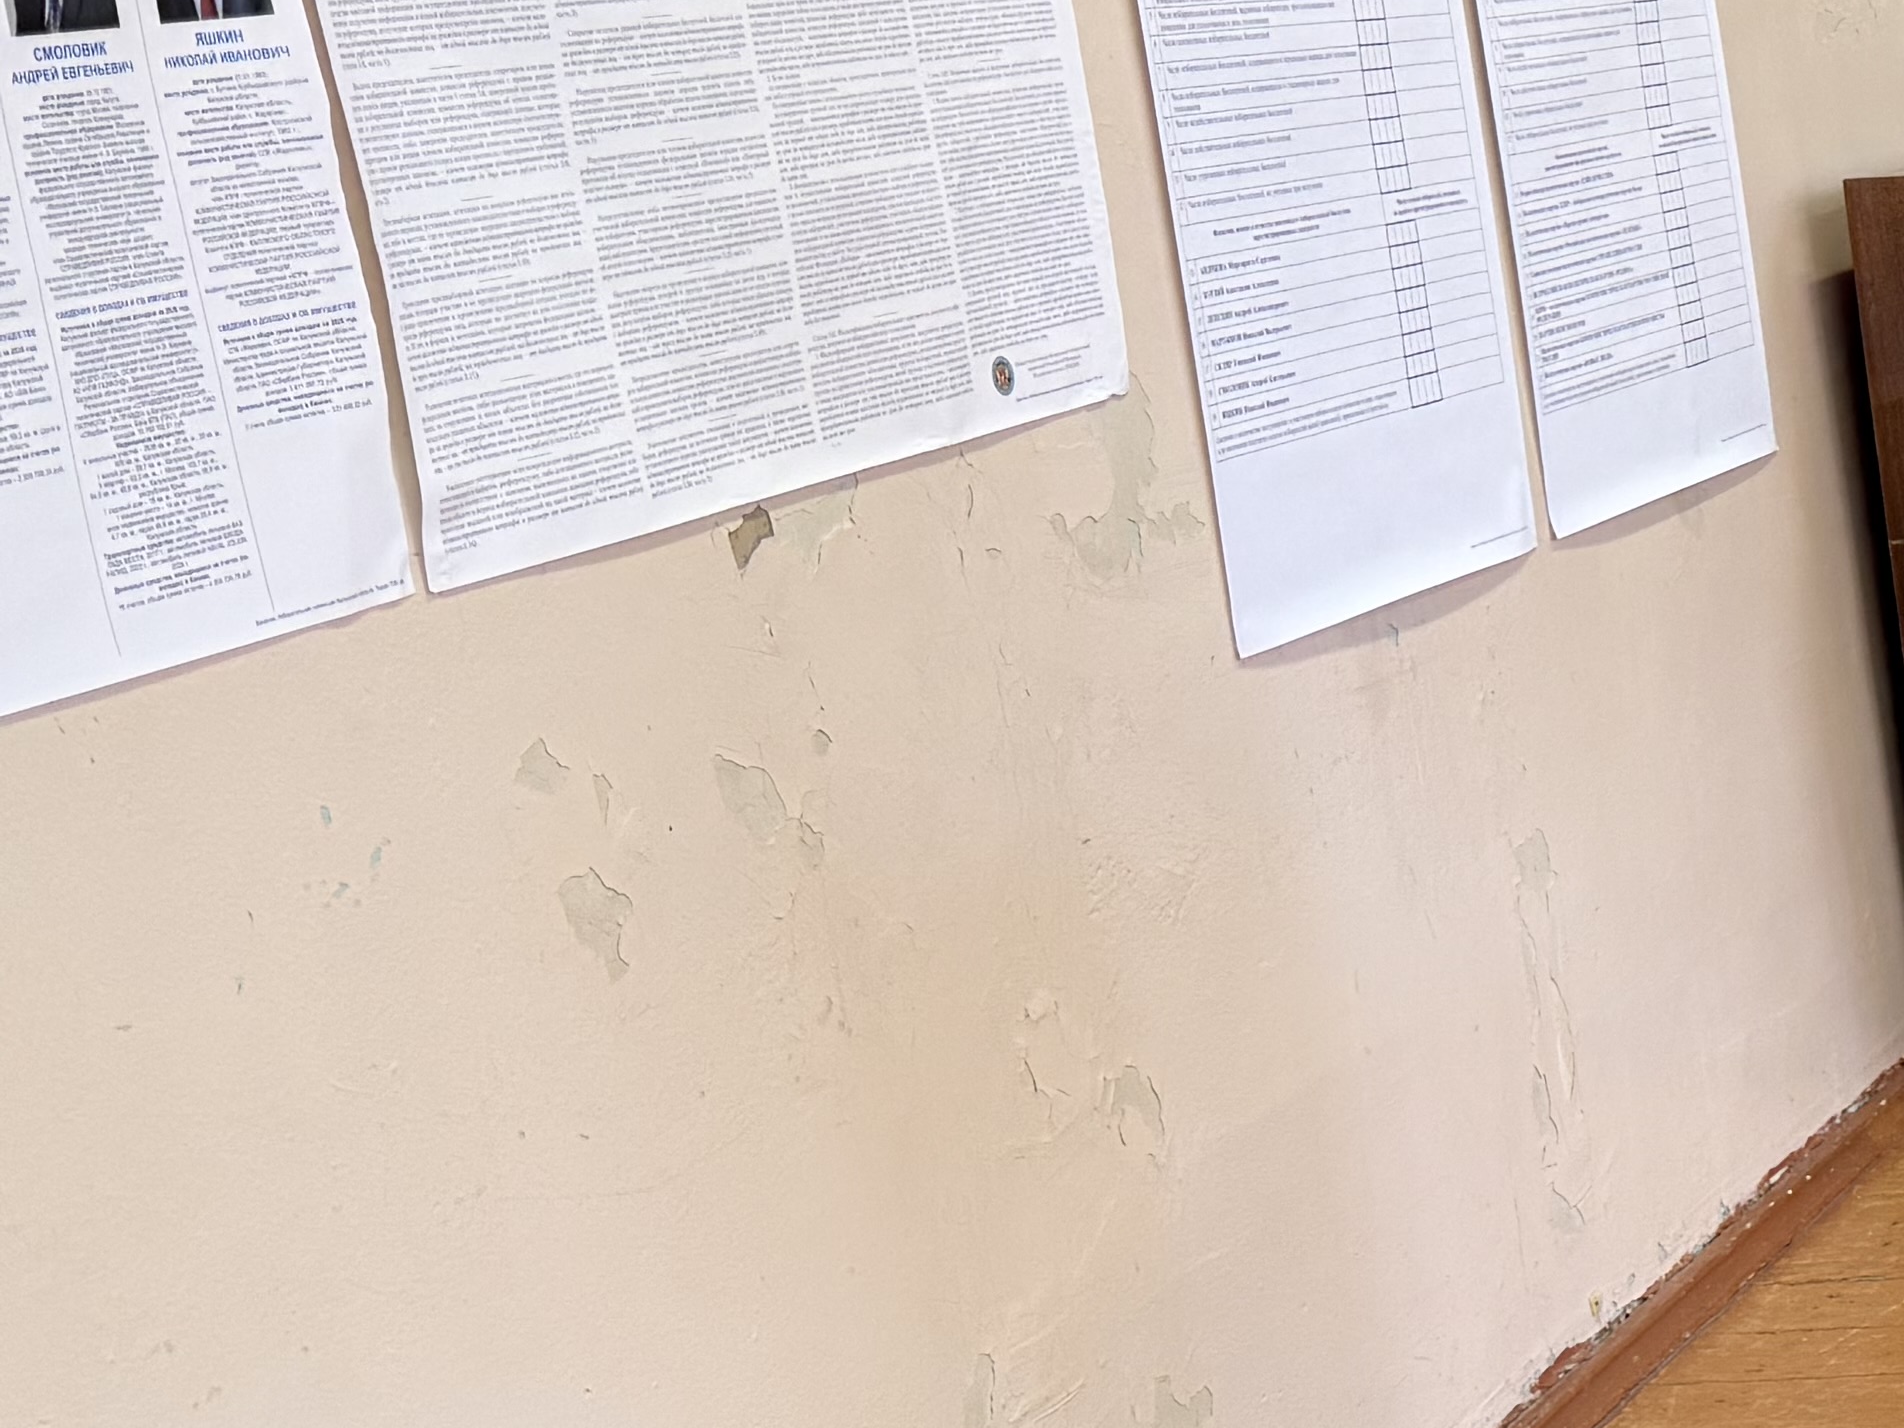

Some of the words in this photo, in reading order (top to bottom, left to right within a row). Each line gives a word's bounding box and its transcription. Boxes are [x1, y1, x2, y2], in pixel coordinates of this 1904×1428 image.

[194, 29, 244, 47] ЯШКИН
[33, 41, 108, 62] СМОЛОВИК
[164, 50, 217, 69] НИКОЛАЙ
[220, 45, 290, 63] ИВАНОВИЧ
[12, 66, 59, 85] АНДРЕЙ
[61, 60, 134, 80] ЕВГЕНЬЕВИЧ
